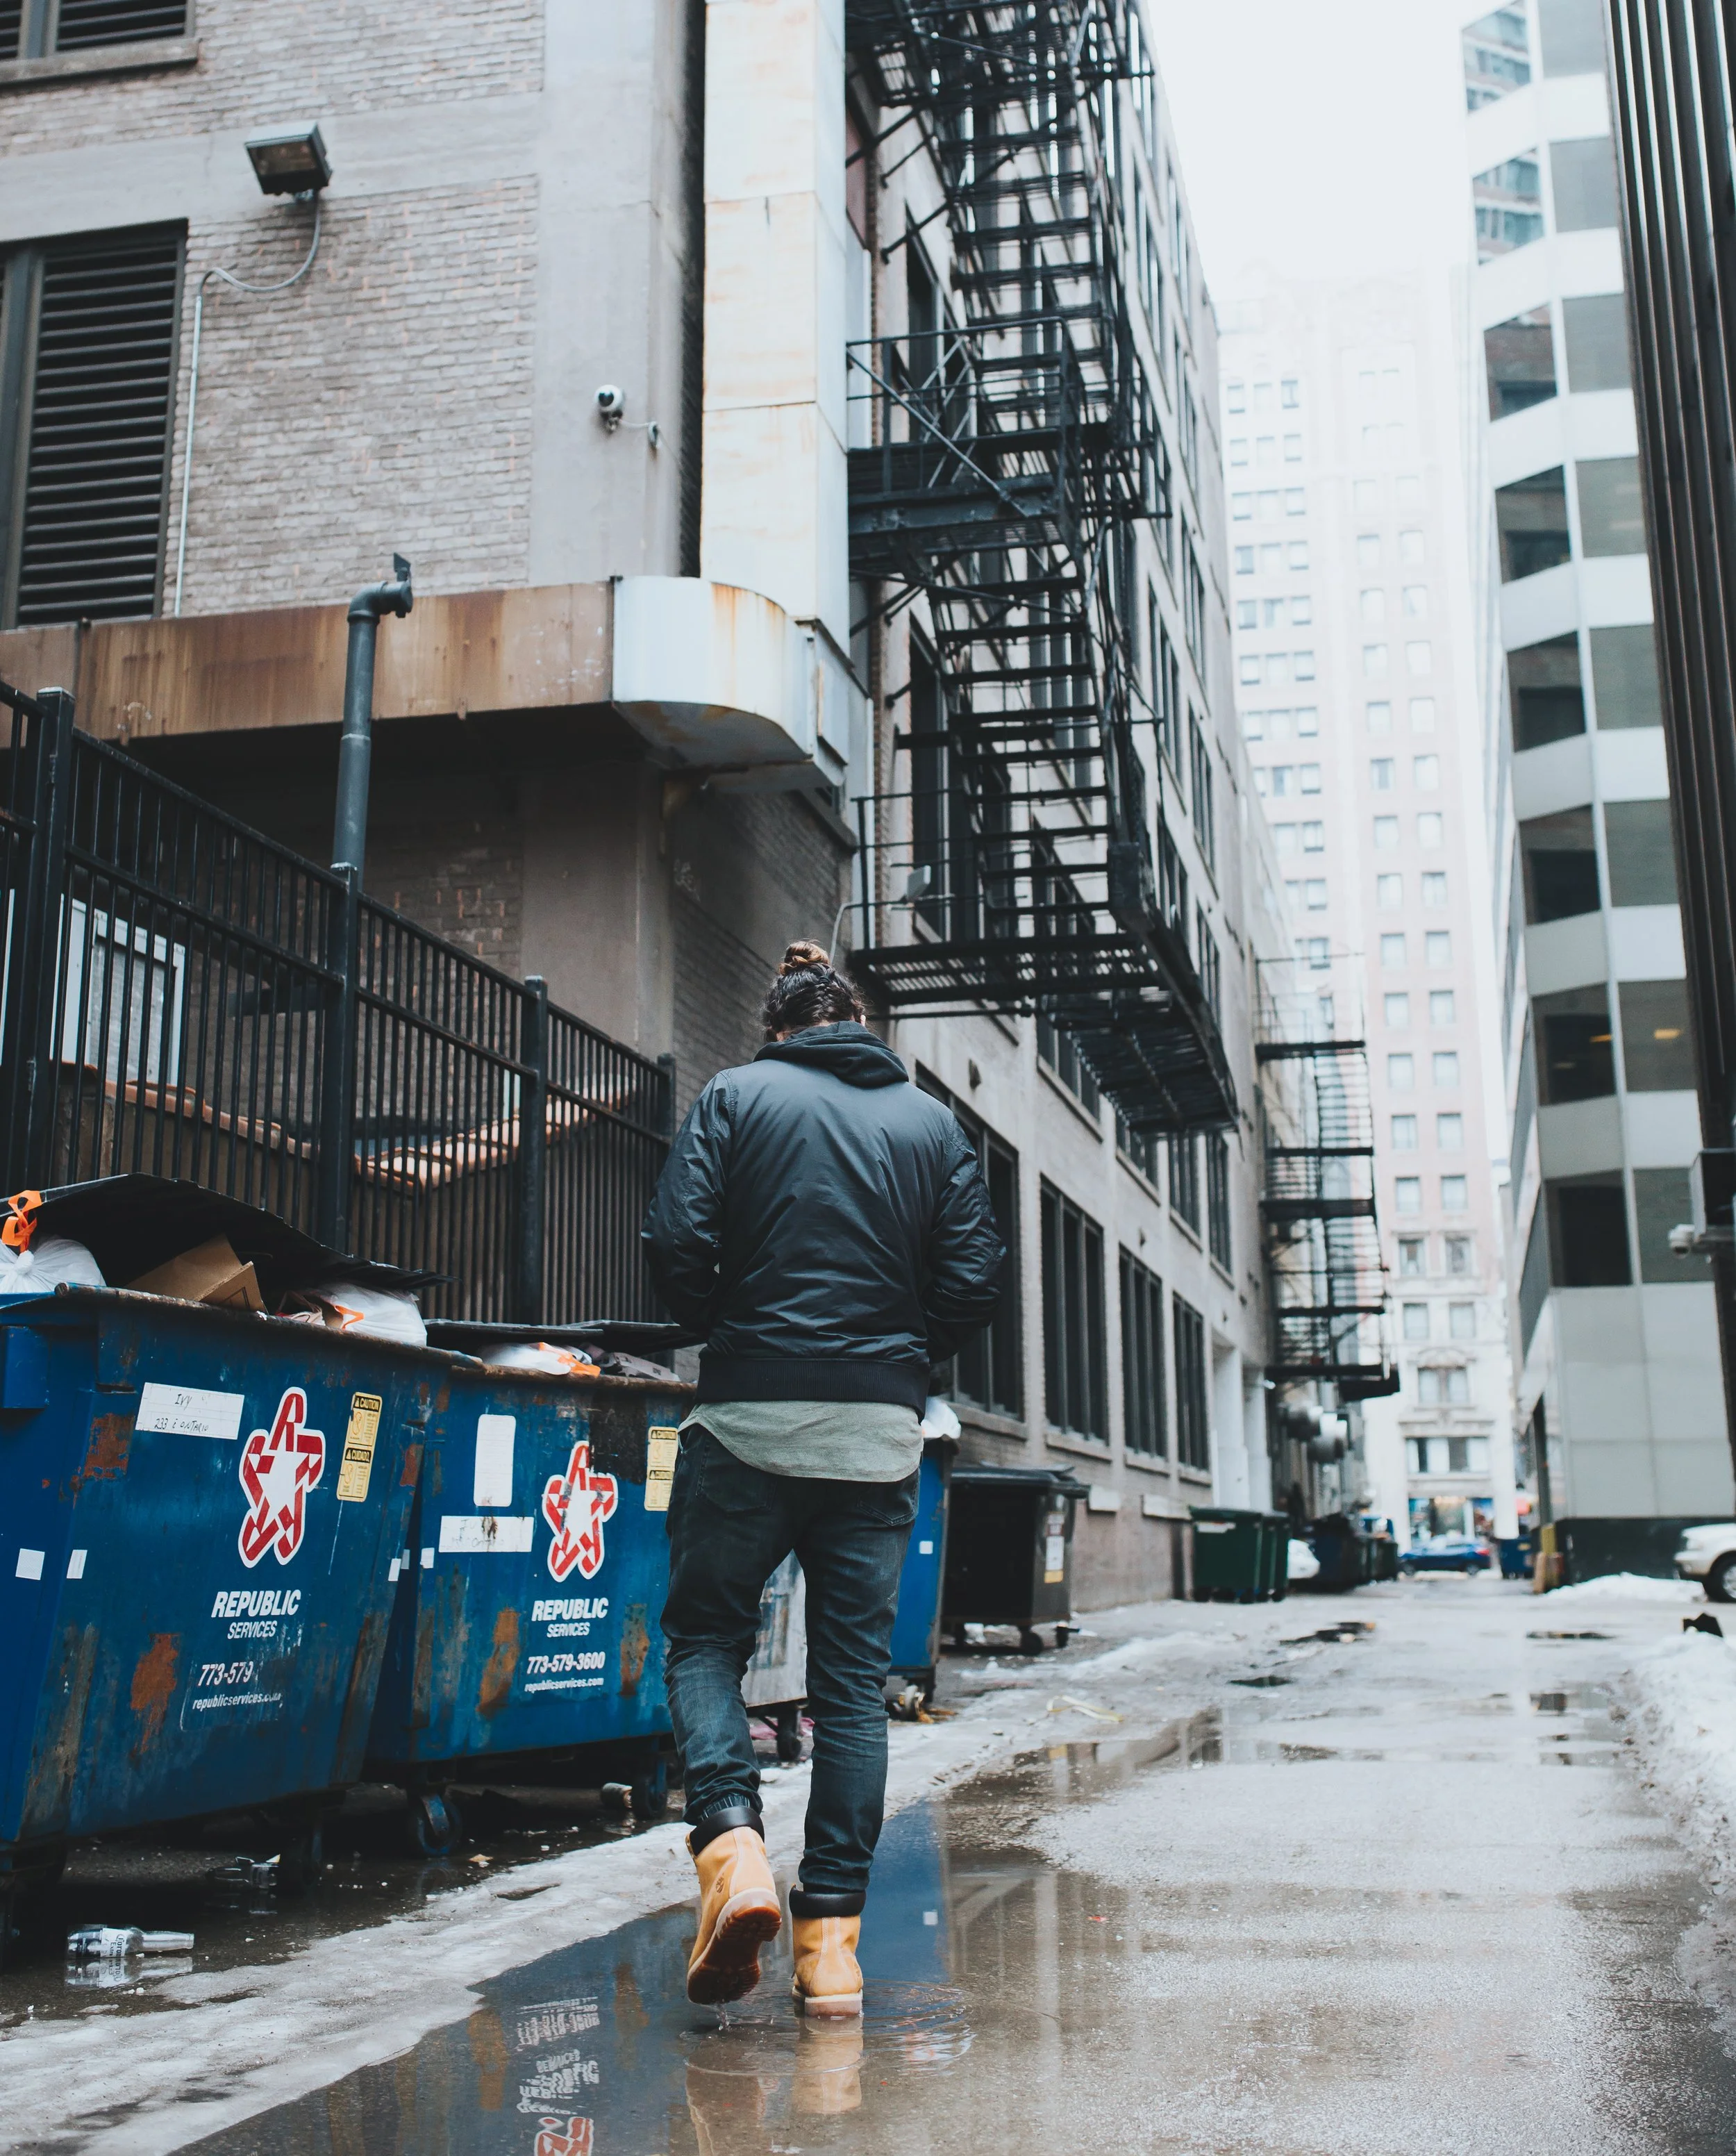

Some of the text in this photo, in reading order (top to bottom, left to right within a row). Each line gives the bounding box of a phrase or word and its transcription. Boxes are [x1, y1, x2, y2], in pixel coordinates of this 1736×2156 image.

[154, 1418, 168, 1429] 233
[180, 1420, 209, 1432] ONTARIO
[211, 1589, 301, 1618] REPUBLIC
[531, 1597, 609, 1622] REPUBLIC
[227, 1620, 278, 1639] SERVICES
[546, 1622, 591, 1638] SERVICES
[526, 1651, 606, 1675] 773-579-3600
[524, 1677, 604, 1694] republicservices.com
